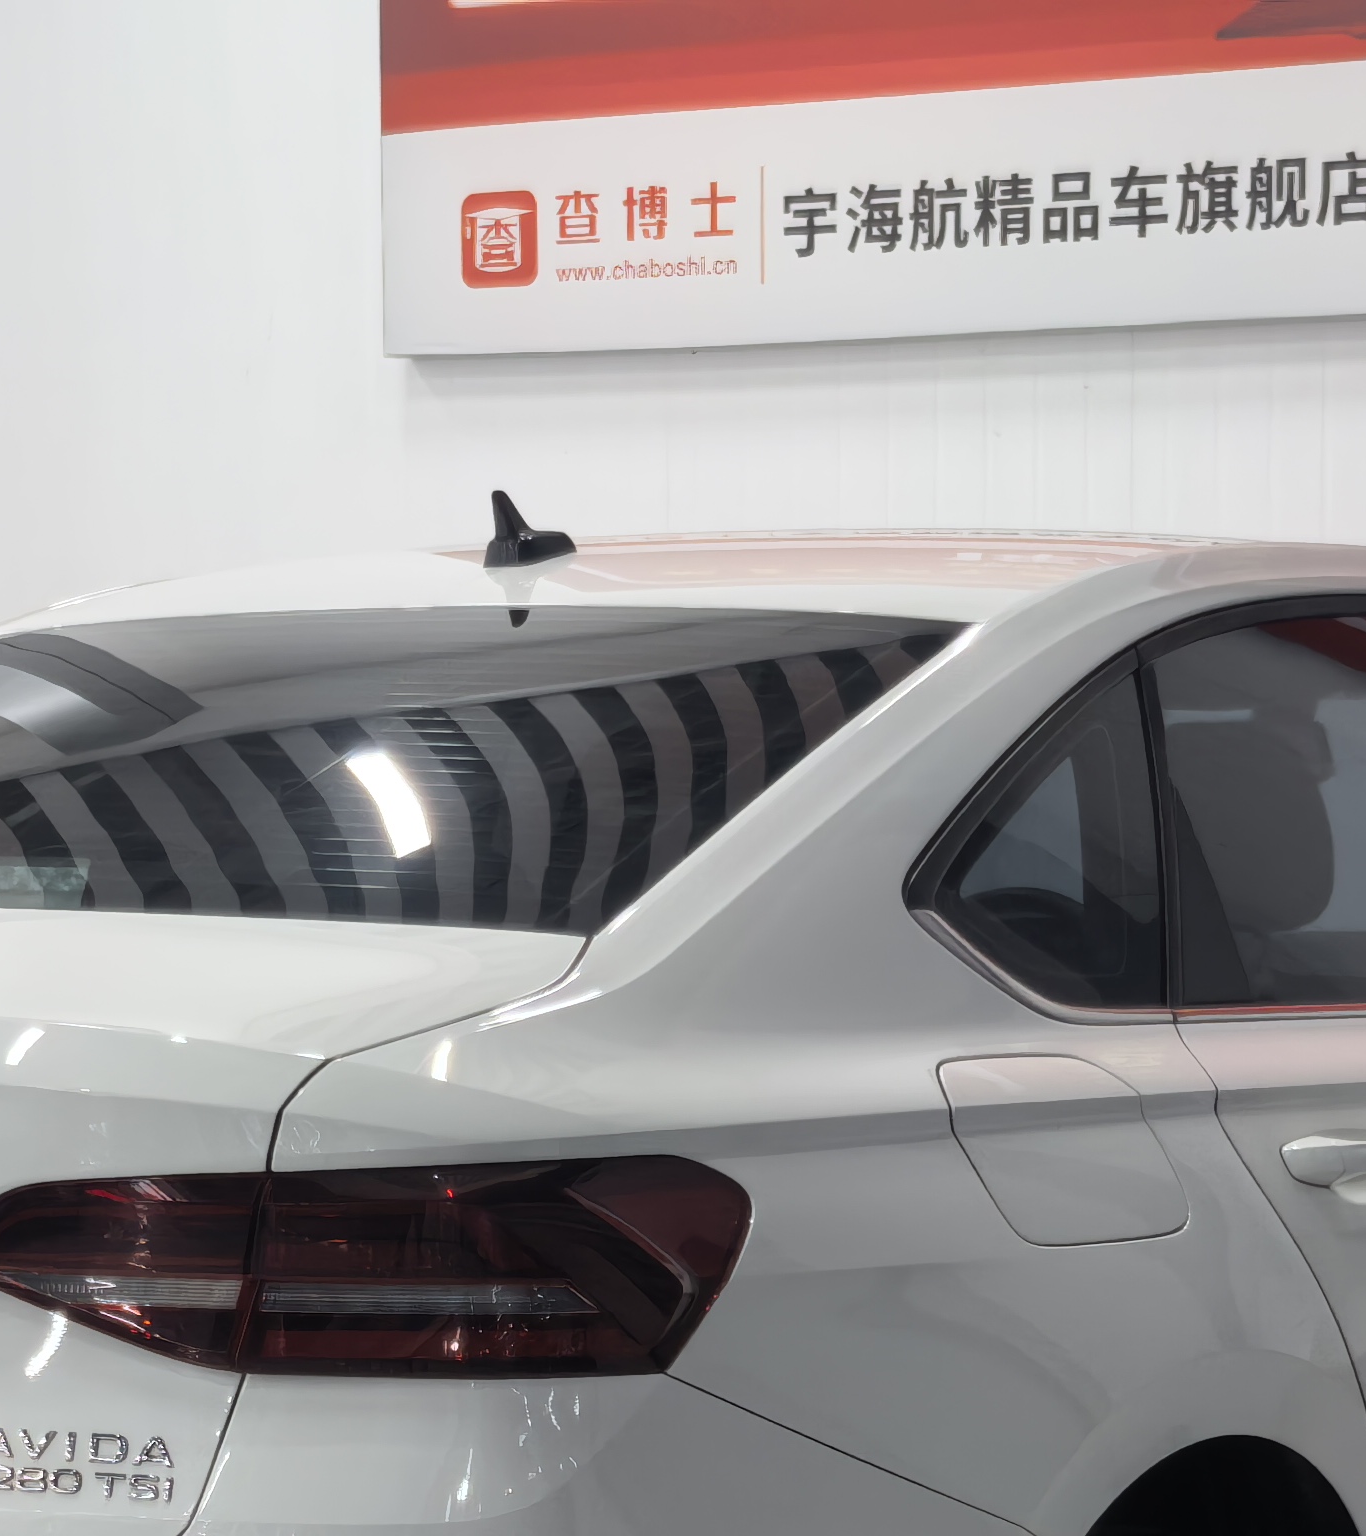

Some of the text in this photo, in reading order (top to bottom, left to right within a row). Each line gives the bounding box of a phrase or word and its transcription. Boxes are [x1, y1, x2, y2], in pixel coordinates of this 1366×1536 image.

[554, 181, 737, 245] 查博士
[555, 256, 738, 282] www.chaboshi.cn
